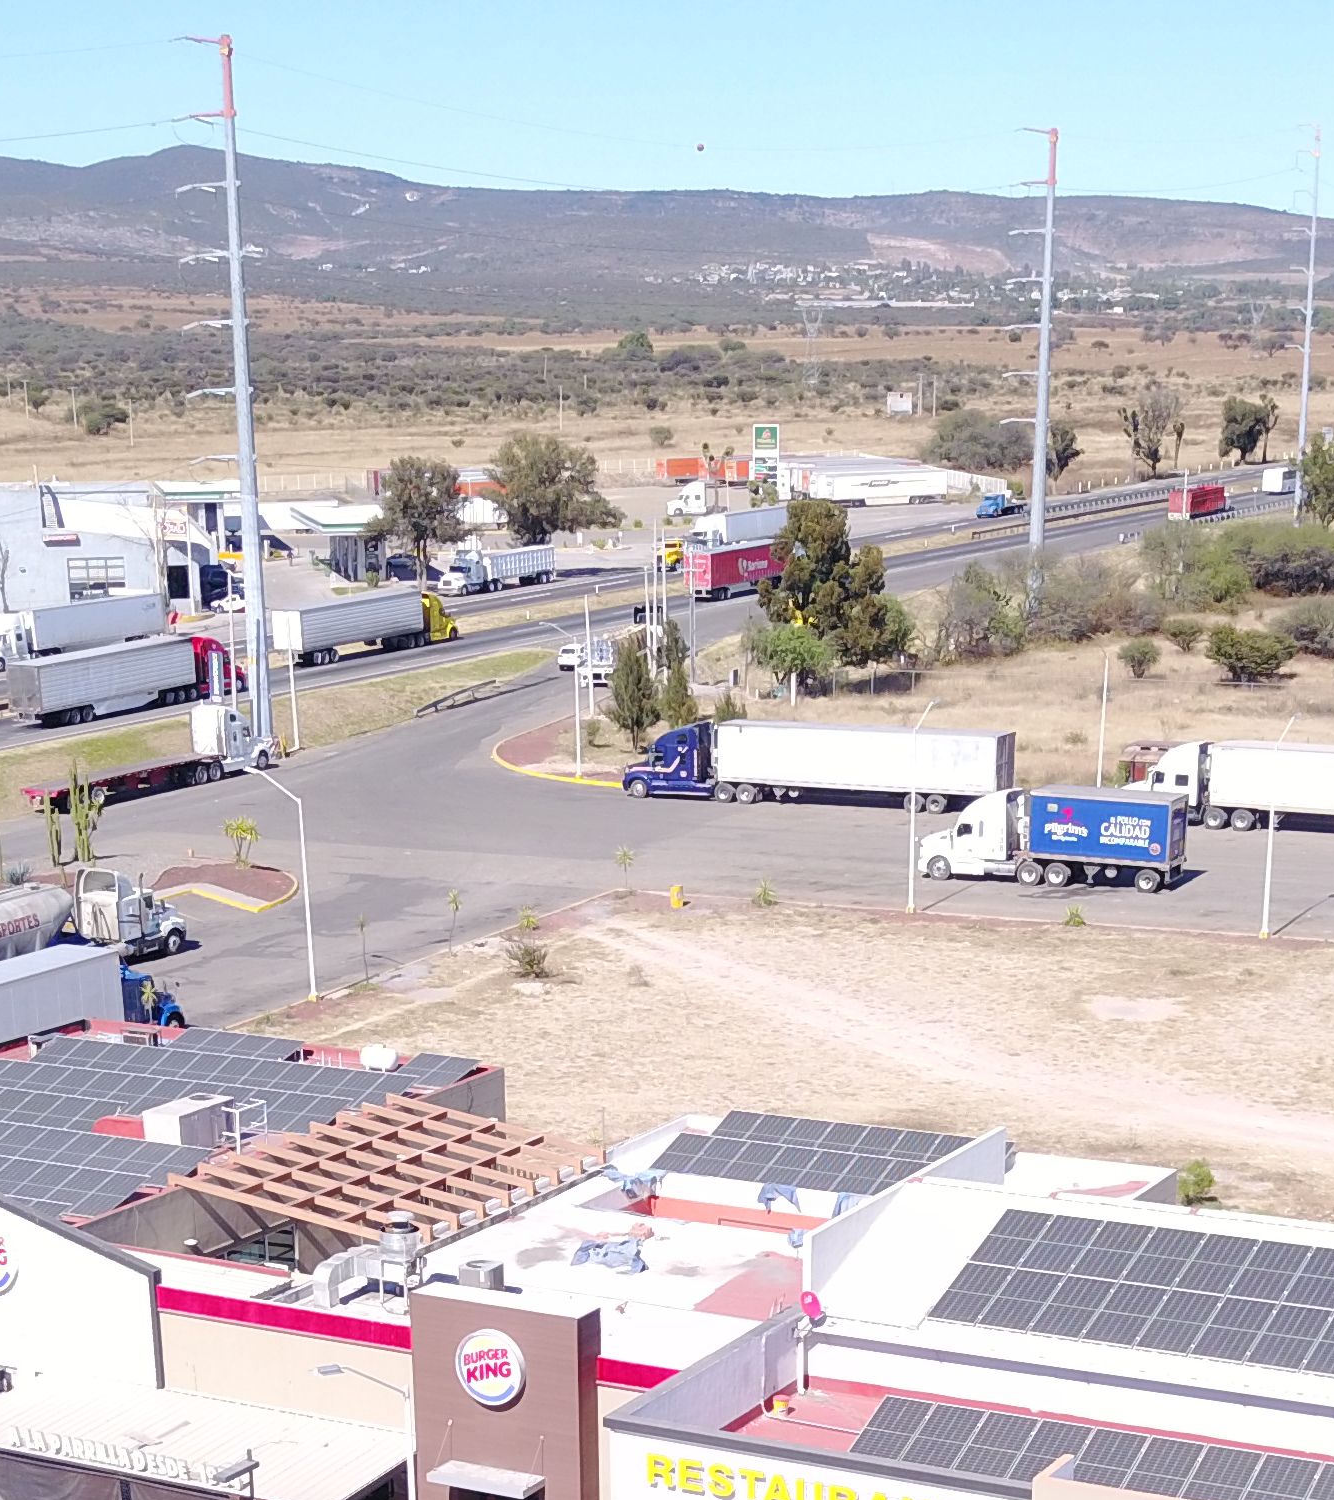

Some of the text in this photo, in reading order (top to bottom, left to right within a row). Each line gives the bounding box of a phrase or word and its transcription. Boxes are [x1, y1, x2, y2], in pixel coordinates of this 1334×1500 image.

[1100, 823, 1150, 838] CALIDAD
[463, 1348, 508, 1366] BURGER
[466, 1361, 512, 1384] KING
[48, 1432, 132, 1470] PARRILLA
[130, 1447, 193, 1482] DESDE
